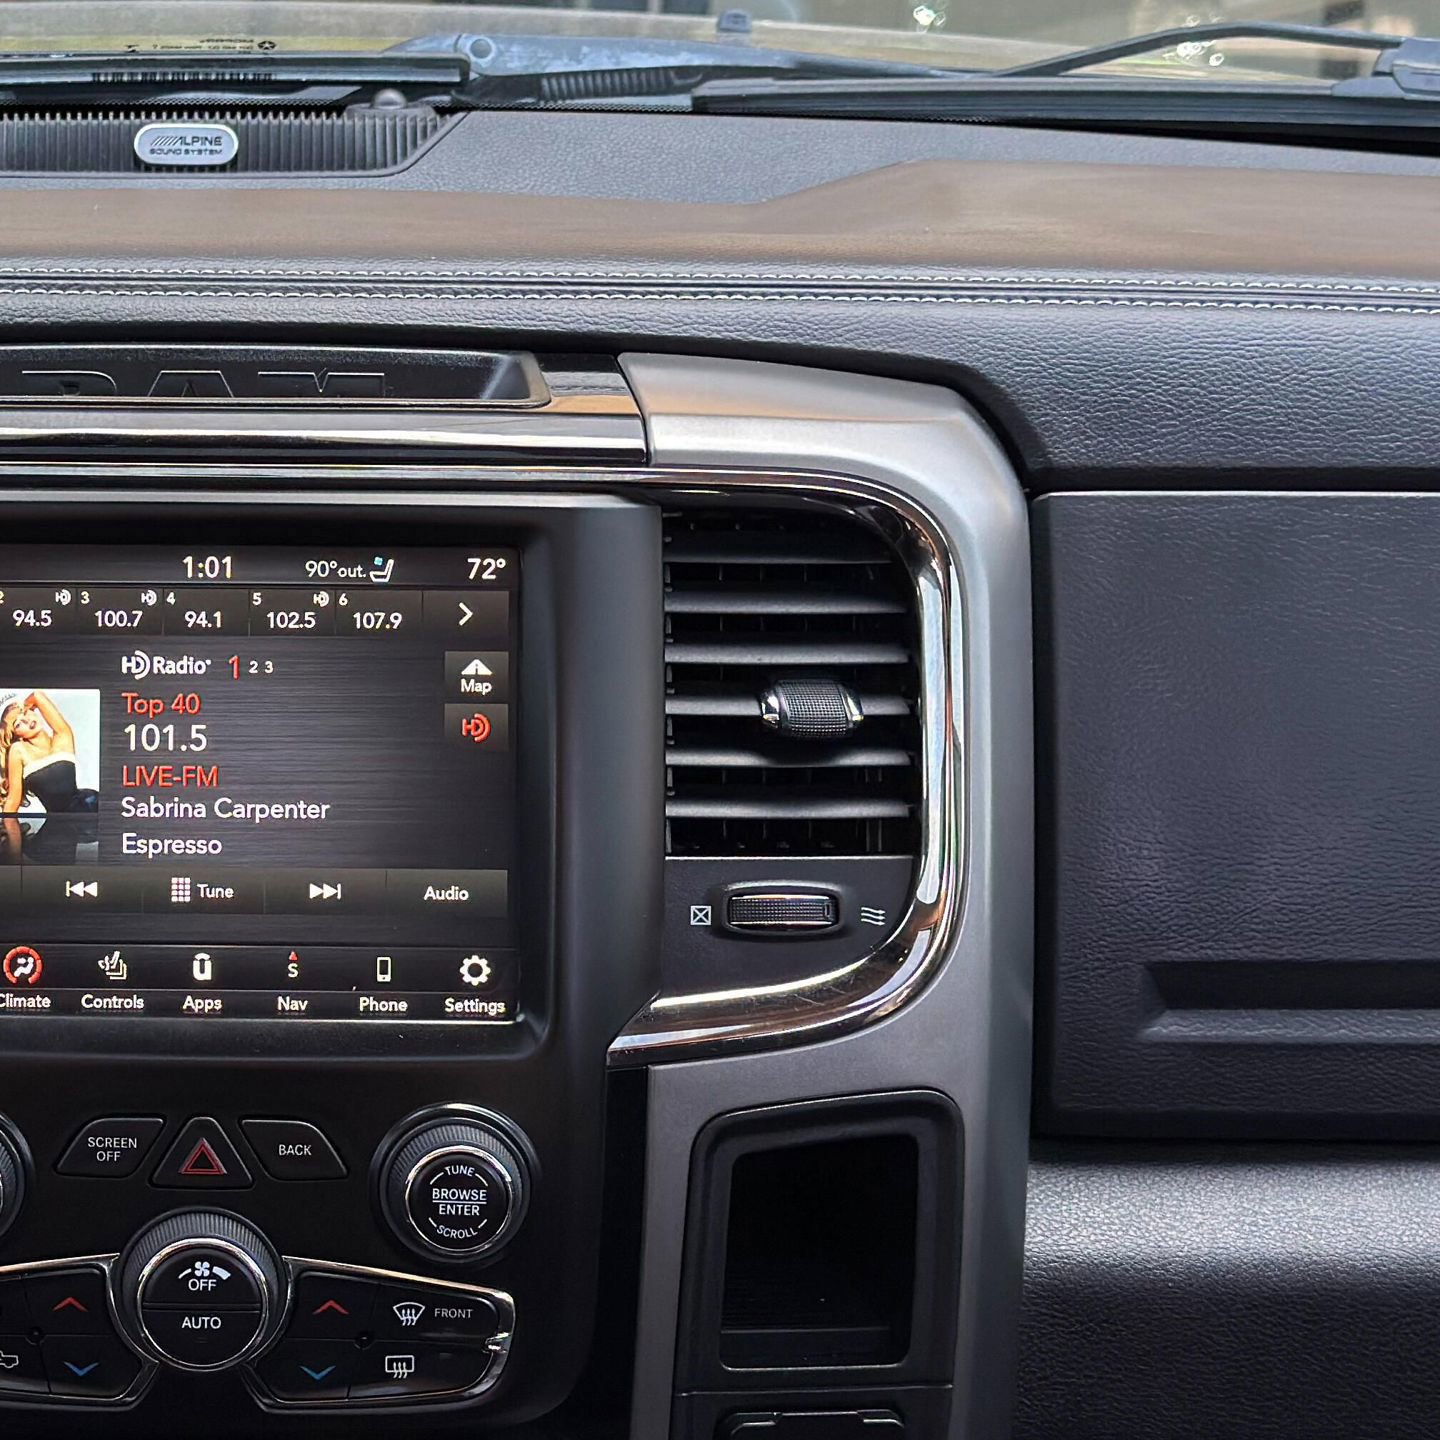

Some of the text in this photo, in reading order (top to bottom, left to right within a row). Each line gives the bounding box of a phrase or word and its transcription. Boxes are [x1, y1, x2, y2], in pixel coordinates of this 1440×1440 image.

[157, 135, 223, 147] ALPINE
[149, 147, 223, 156] SOUND SYSTEM
[182, 555, 234, 580] 1:01
[466, 557, 507, 581] 72°
[79, 590, 90, 605] 3
[165, 591, 176, 606] 4
[252, 591, 263, 607] 5
[338, 592, 349, 607] 6
[12, 609, 53, 628] 94.5
[94, 610, 143, 628] 100.7
[183, 610, 223, 629] 94.1
[266, 610, 317, 630] 102.5
[352, 611, 403, 631] 107.9
[151, 656, 208, 675] Radio
[228, 654, 241, 681] 1
[248, 661, 260, 674] 2
[263, 660, 275, 675] 3
[460, 678, 493, 696] Map
[121, 691, 201, 719] Top 40
[123, 723, 209, 752] 101.5
[121, 765, 219, 788] LIVE-FM
[120, 795, 331, 824] Sabrina Carpenter
[121, 832, 223, 859] Espresso
[196, 883, 235, 900] Tune
[423, 885, 470, 902] Audio
[287, 962, 299, 979] S
[80, 993, 145, 1010] Controls
[182, 995, 223, 1013] Apps
[277, 995, 309, 1011] Nav
[358, 995, 409, 1013] Phone
[443, 997, 506, 1016] Settings
[86, 1136, 138, 1150] SCREEN
[277, 1143, 313, 1157] BACK
[95, 1150, 122, 1163] OFF
[444, 1164, 476, 1178] TUNE
[431, 1187, 488, 1202] BROWSE
[438, 1203, 481, 1217] ENTER
[435, 1223, 479, 1240] SCROLL
[187, 1278, 218, 1292] OFF
[433, 1307, 474, 1320] FRONT
[180, 1316, 223, 1330] AUTO
